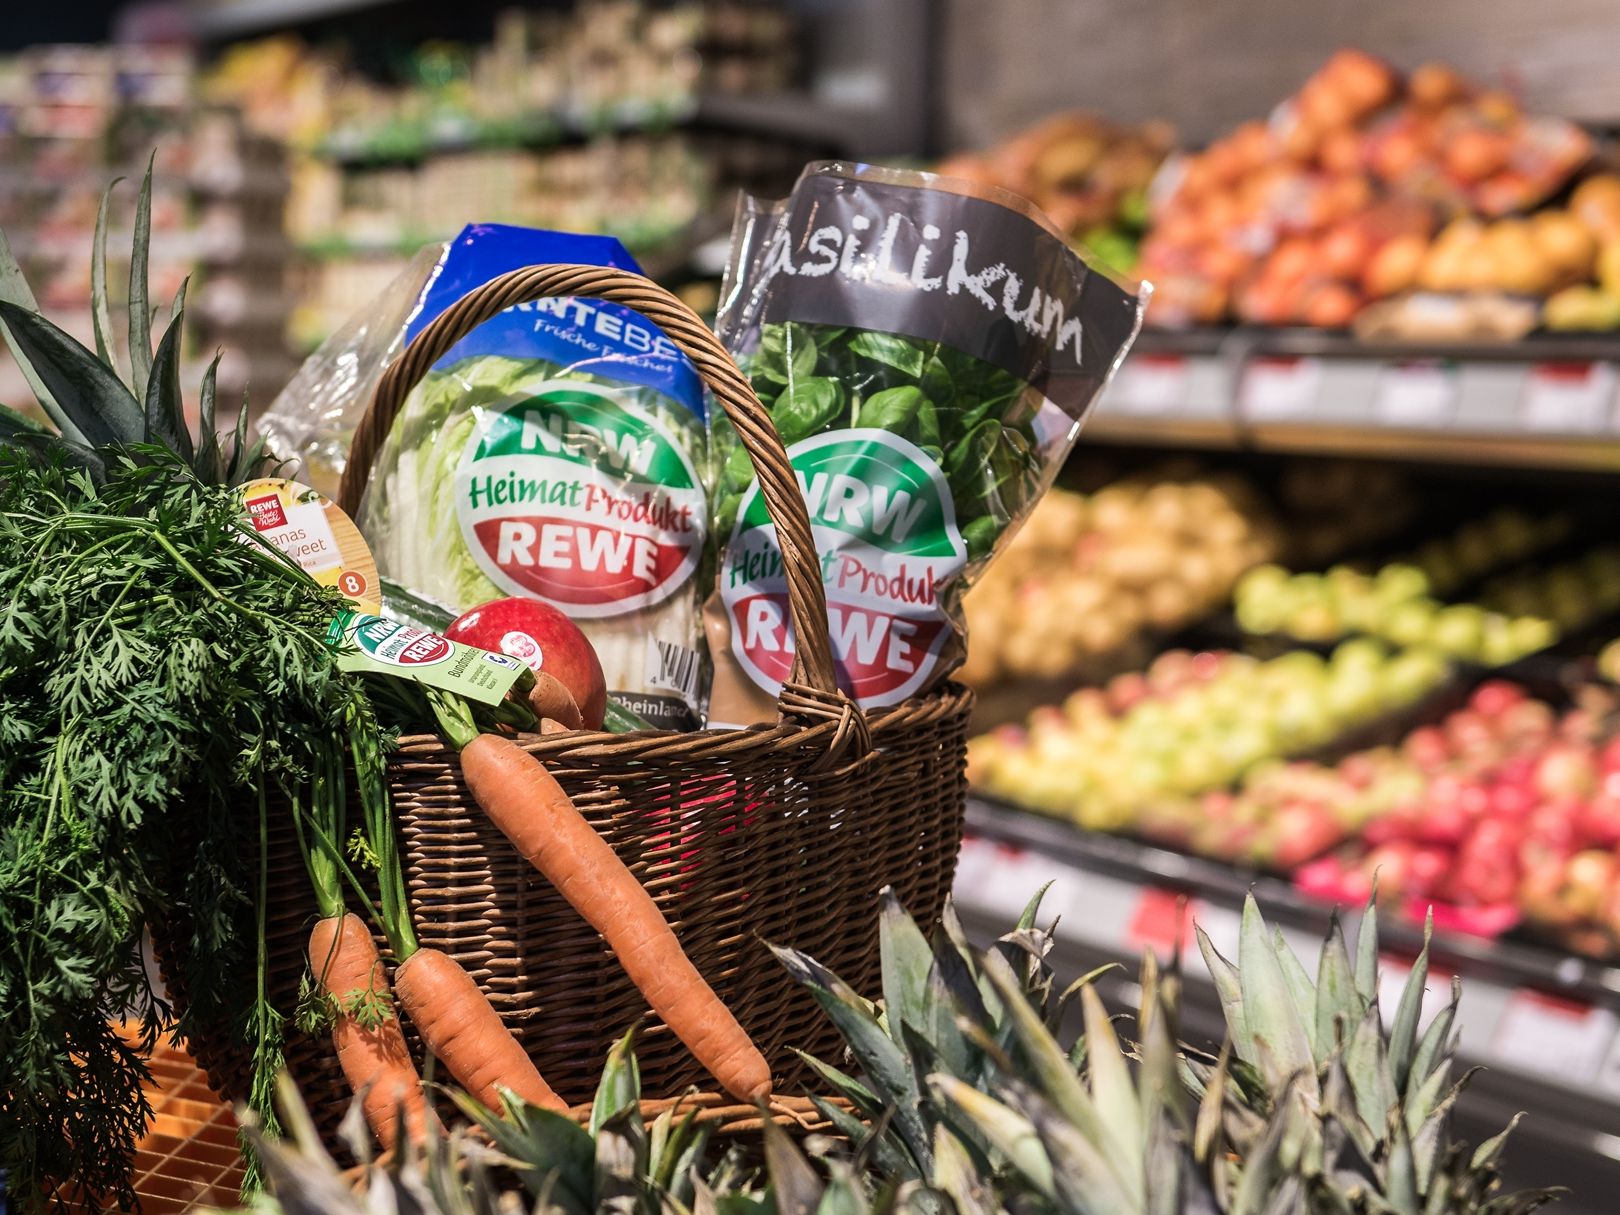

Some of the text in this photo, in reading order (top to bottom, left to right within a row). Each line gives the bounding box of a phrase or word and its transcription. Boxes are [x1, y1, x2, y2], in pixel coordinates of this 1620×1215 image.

[533, 318, 600, 352] Frische
[520, 409, 657, 475] NRW
[250, 499, 279, 514] REWE
[497, 521, 659, 587] REWE
[344, 575, 360, 594] 8
[403, 633, 445, 662] REWE
